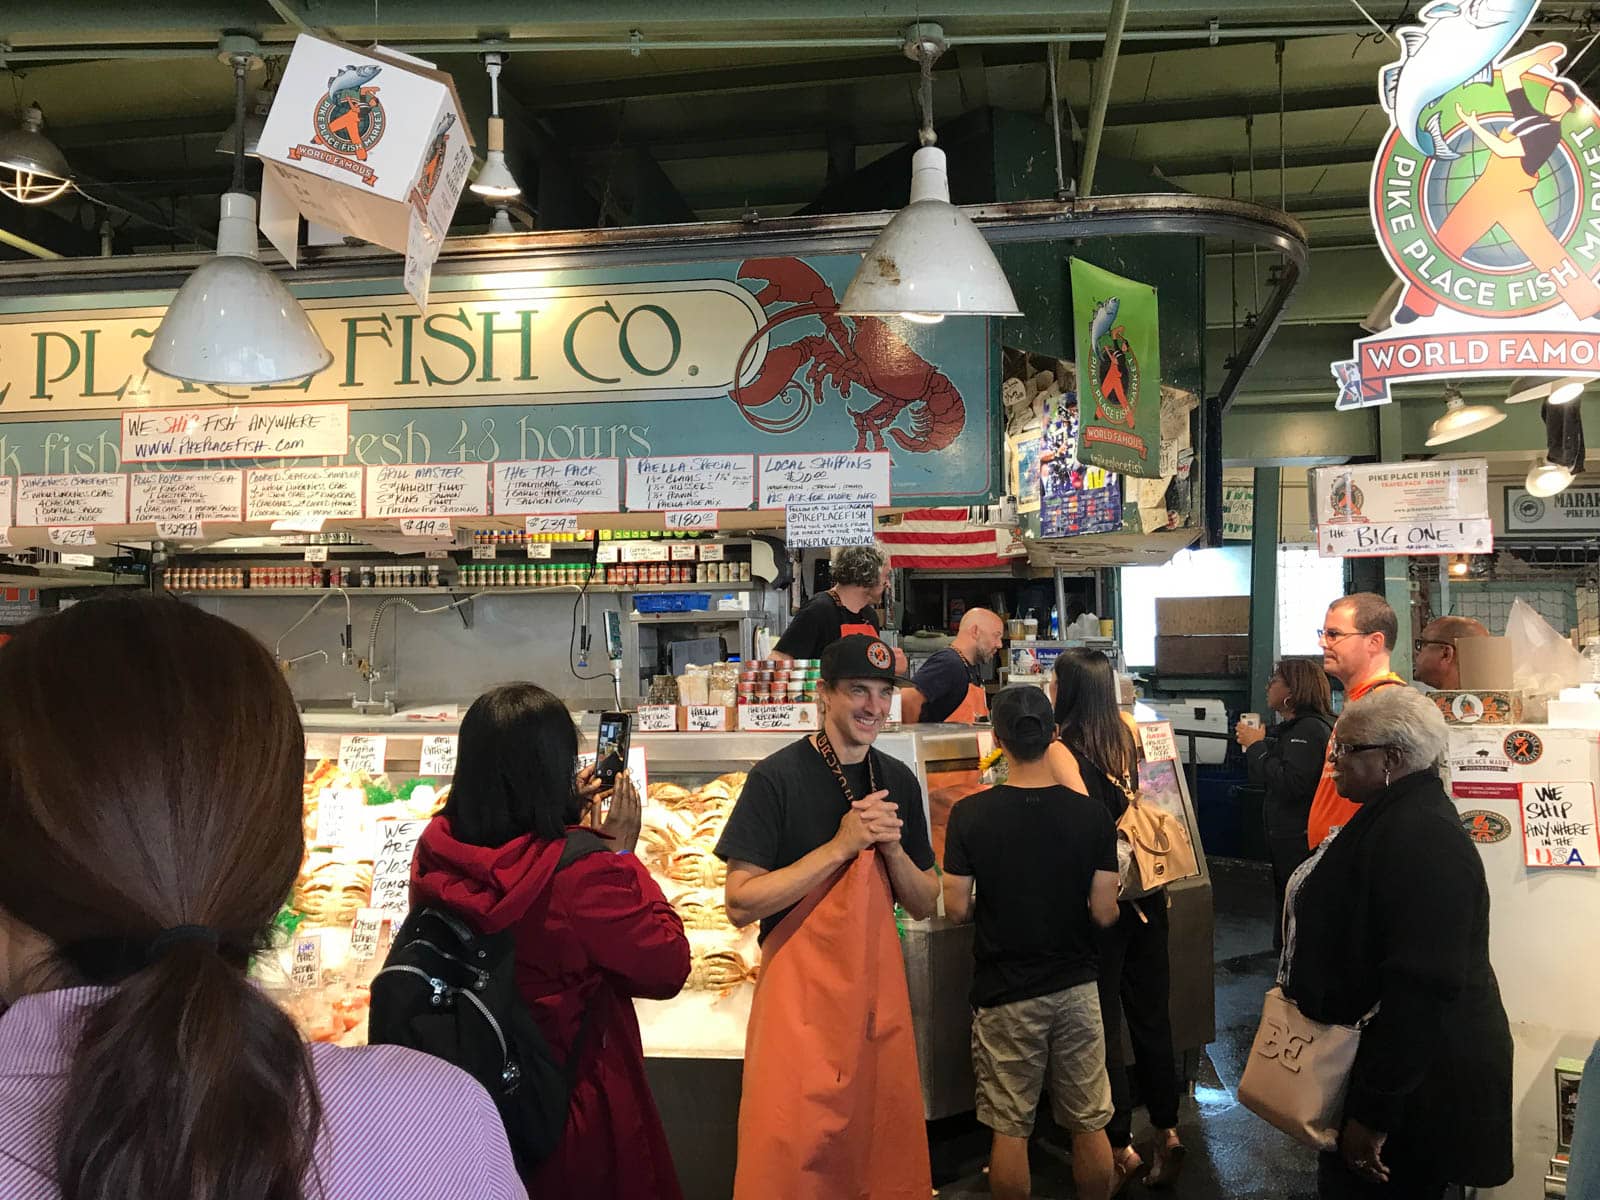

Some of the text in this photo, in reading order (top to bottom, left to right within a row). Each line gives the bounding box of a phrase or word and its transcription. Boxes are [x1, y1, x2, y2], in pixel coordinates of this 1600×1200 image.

[317, 101, 330, 122] PIKE
[319, 124, 341, 148] PLACE
[364, 111, 382, 147] MARKET
[299, 145, 372, 177] WORLD FAMOUS
[1386, 156, 1417, 234] PIKE
[1402, 237, 1496, 307] PLACE
[1507, 258, 1578, 306] FISH
[340, 306, 538, 389] FISH
[562, 300, 700, 379] CO.
[1367, 340, 1489, 371] WORLD
[128, 414, 155, 437] WE
[203, 413, 239, 433] FISH
[248, 413, 327, 435] ANYWHERE
[40, 430, 122, 477] fish
[448, 418, 501, 463] 48
[516, 415, 656, 462] hours
[377, 466, 464, 481] GRILL MASTER
[497, 466, 529, 480] THE
[564, 464, 598, 478] PACK
[638, 458, 747, 474] PAELLA SPECIAL
[765, 458, 806, 473] LOCAL
[1368, 473, 1389, 482] PIKE
[1390, 472, 1419, 481] PLACE
[1420, 470, 1441, 479] FISH
[1356, 525, 1399, 547] BIG
[1407, 522, 1452, 544] ONE
[1535, 784, 1565, 802] WE
[1526, 802, 1573, 819] SHIP
[385, 823, 417, 839] WE
[1526, 821, 1594, 838] ANYWHERE
[381, 839, 418, 856] ARE
[1541, 836, 1578, 846] IN THE
[1535, 847, 1585, 866] USA
